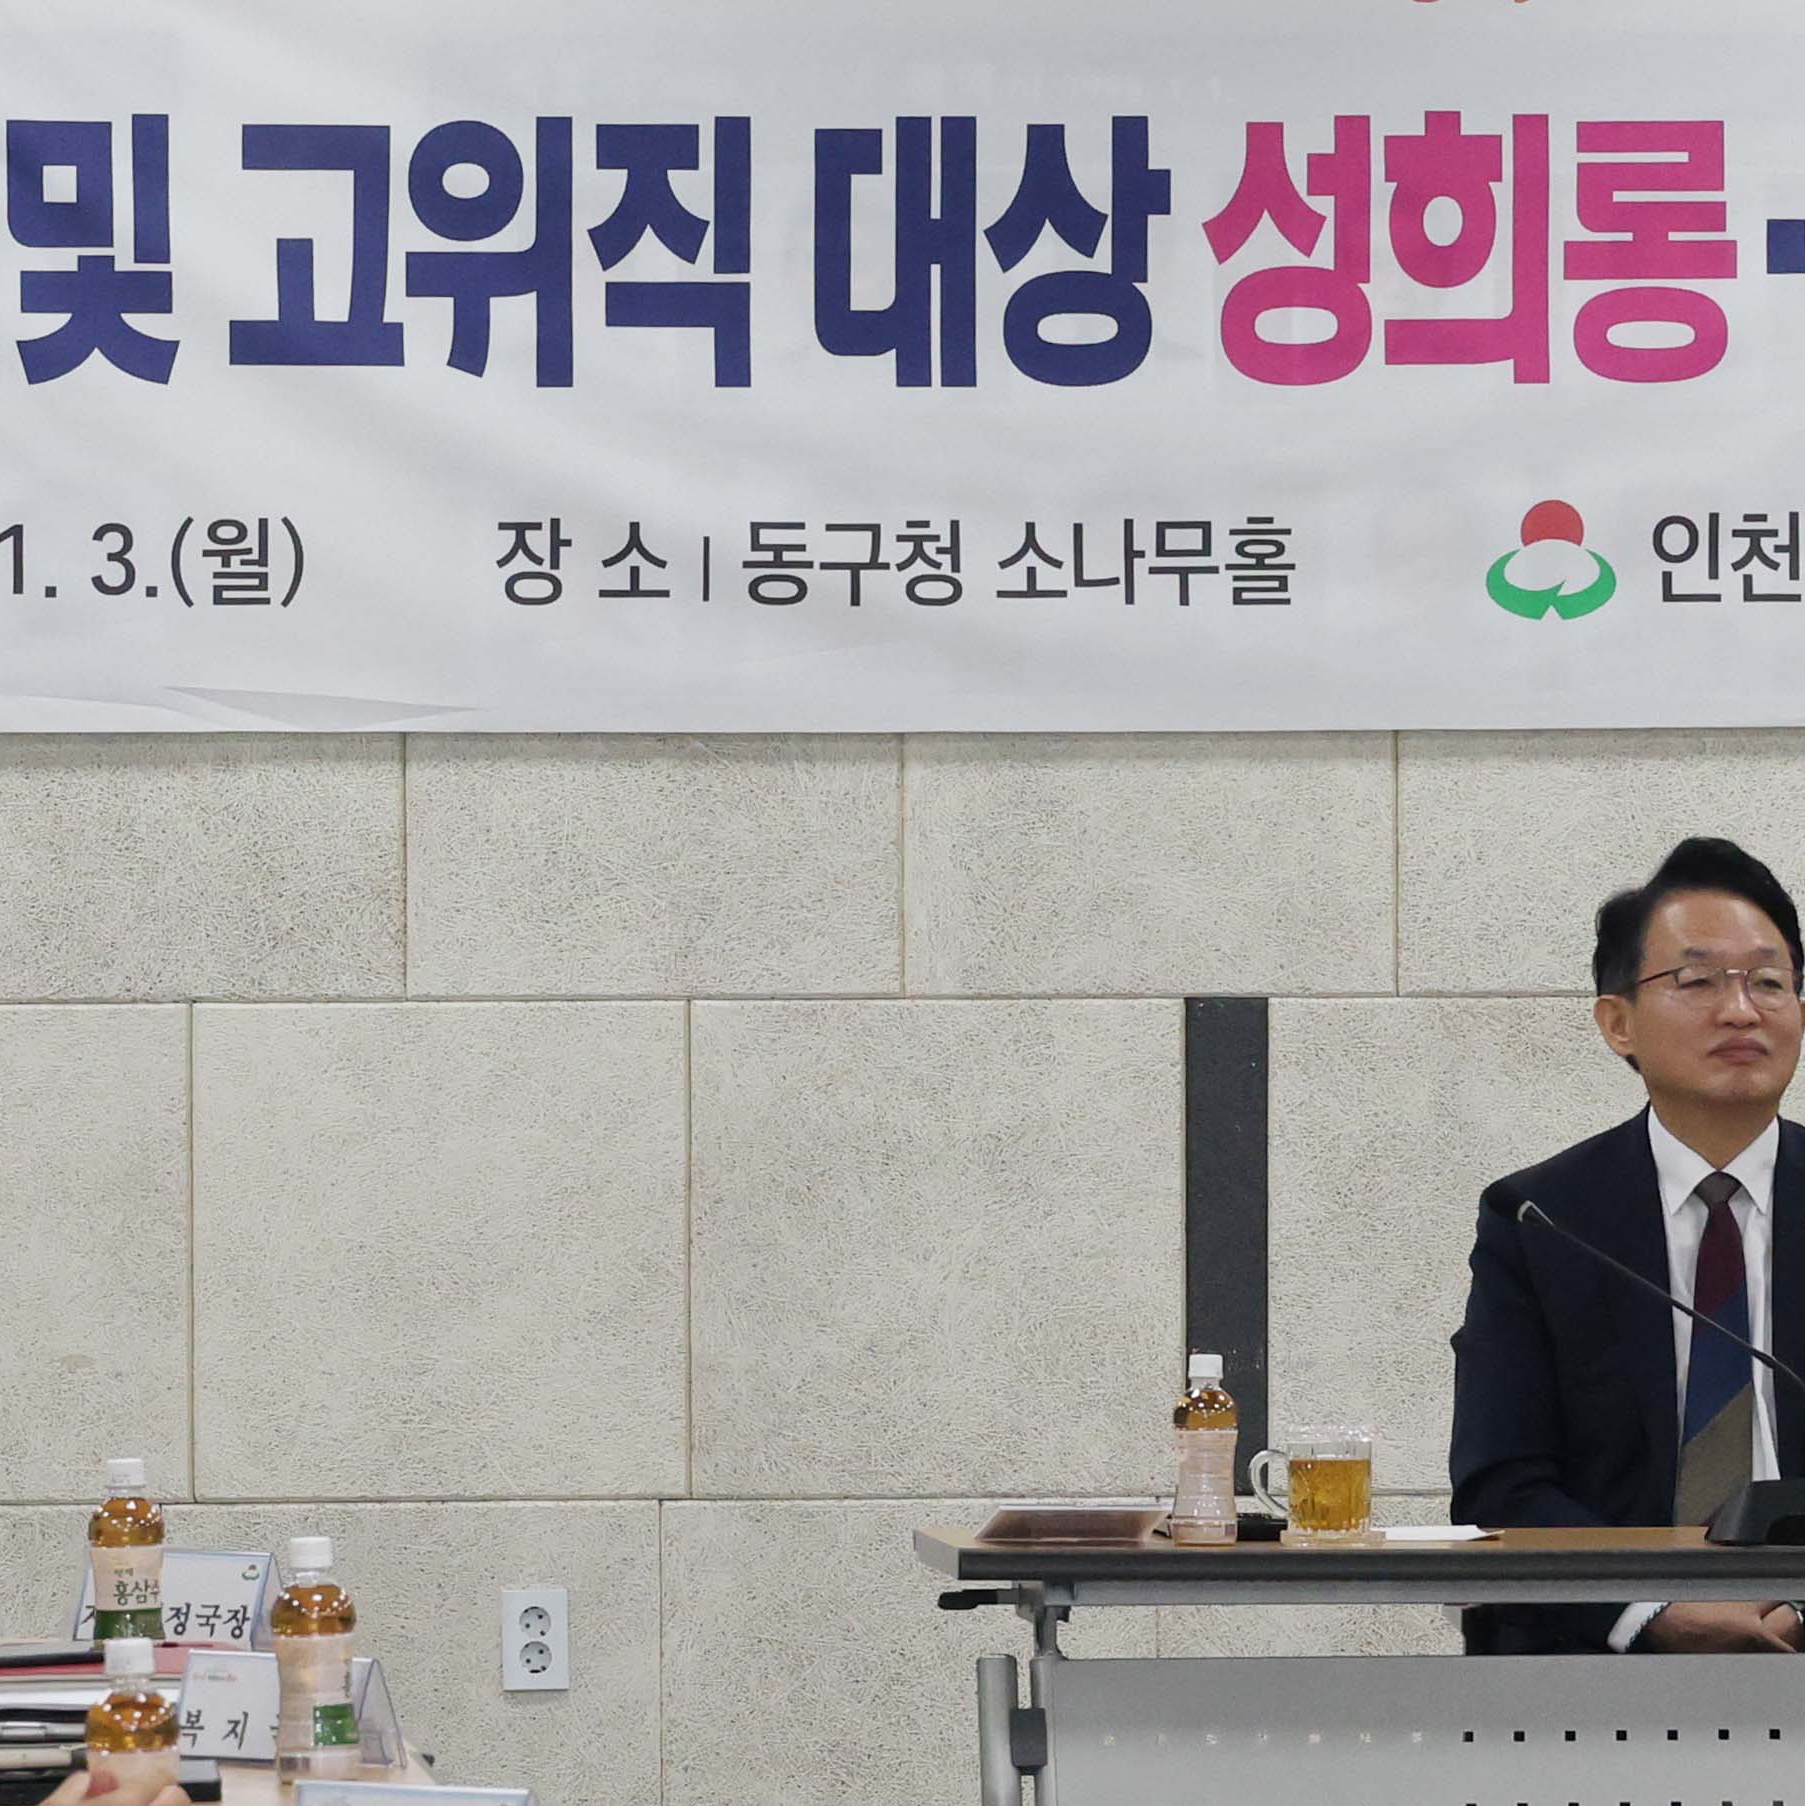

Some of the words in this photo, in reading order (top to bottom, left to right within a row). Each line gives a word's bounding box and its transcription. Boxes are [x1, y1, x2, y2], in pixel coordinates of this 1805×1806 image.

[6, 113, 180, 385] 및
[229, 115, 752, 388] 고위직
[813, 115, 1172, 388] 대상
[90, 516, 307, 608] 3.(월)
[742, 519, 965, 607] 동구청
[996, 516, 1297, 607] 소나무홀
[1652, 511, 1803, 603] 인천
